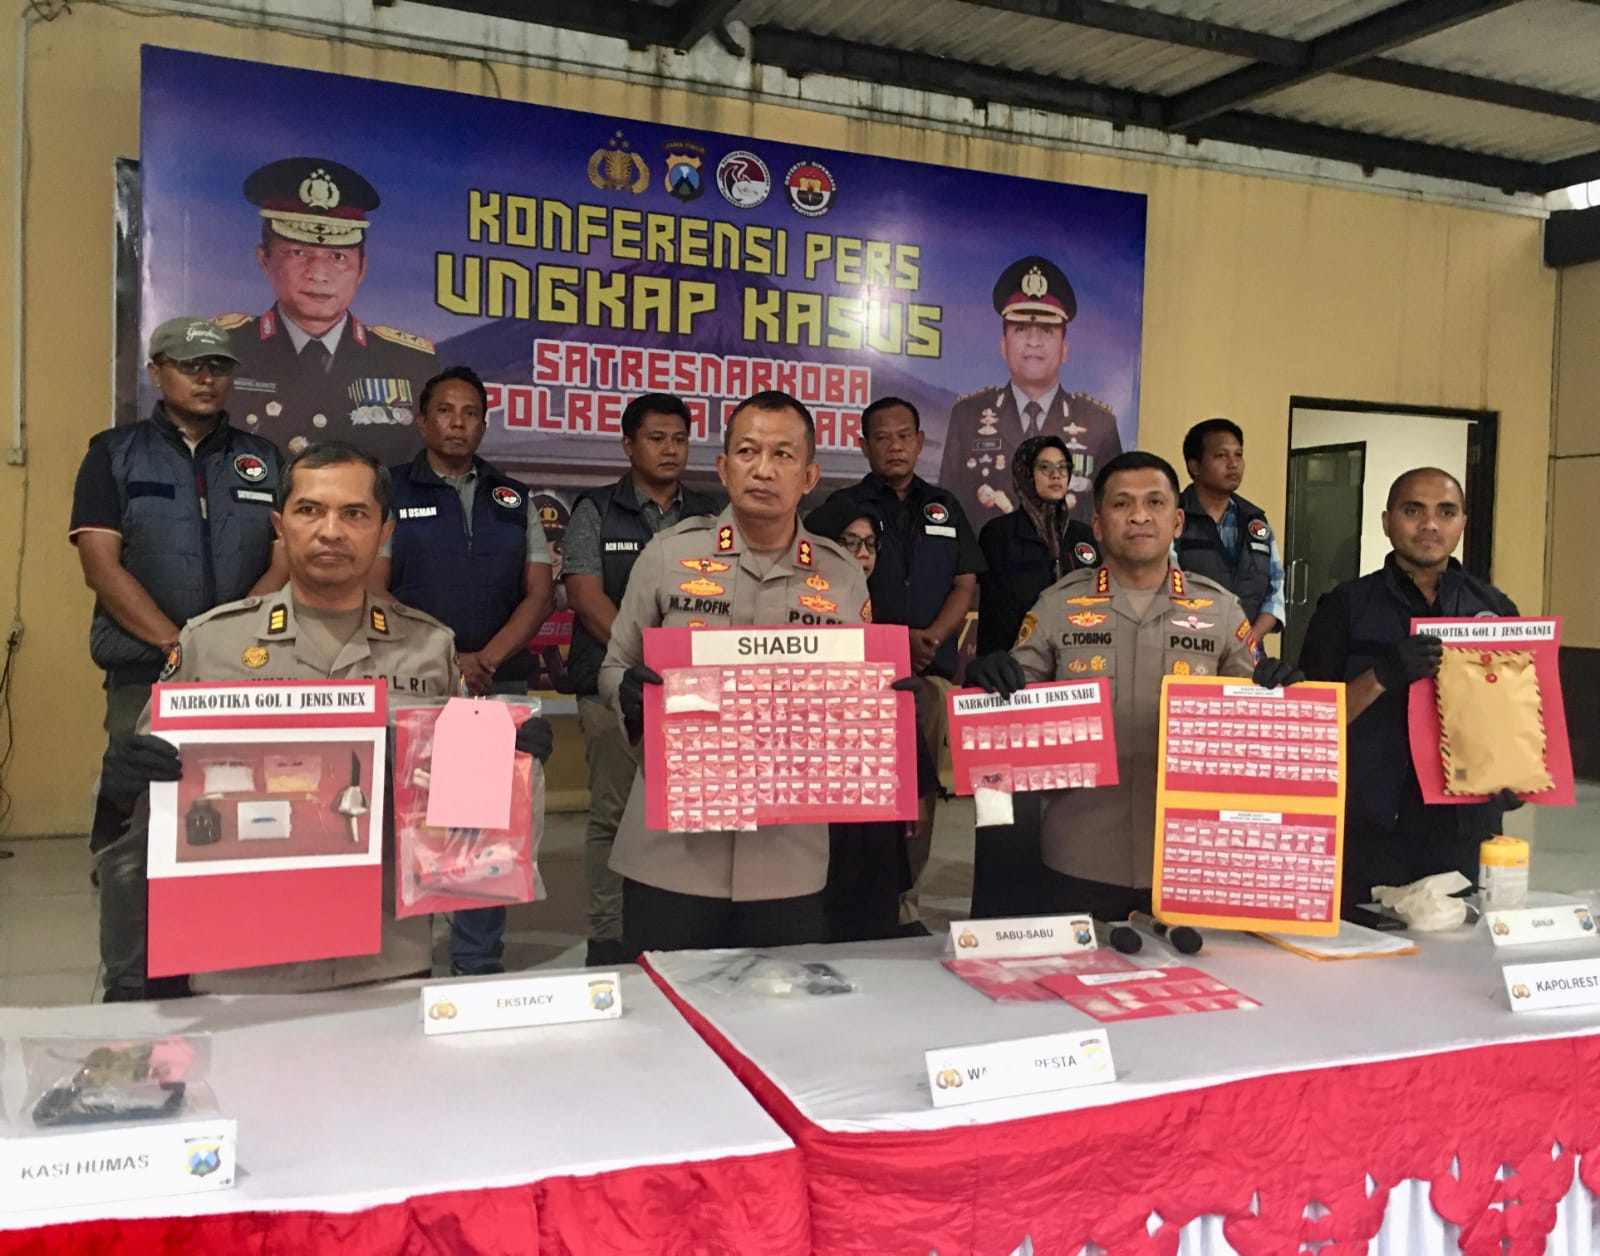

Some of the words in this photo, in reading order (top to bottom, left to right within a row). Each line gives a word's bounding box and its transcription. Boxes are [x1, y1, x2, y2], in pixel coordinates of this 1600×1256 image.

[469, 191, 787, 276] KONFERENSI
[805, 233, 920, 290] PERS
[436, 252, 717, 335] UNGKAP
[744, 287, 943, 358] KASUS
[534, 340, 869, 403] SATRESNARKOBA
[484, 383, 707, 439] POLREA
[738, 636, 819, 655] SHABU
[1170, 635, 1215, 652] POLRI
[170, 693, 250, 710] NARKOTIKA
[255, 693, 282, 708] GOL
[286, 693, 292, 708] I
[300, 692, 333, 708] JENIS
[337, 692, 366, 707] INEX
[1014, 693, 1033, 705] GOL
[1045, 690, 1069, 704] JENIS
[1071, 687, 1095, 701] SABU
[995, 929, 1055, 941] SABU-SABU
[76, 1154, 149, 1176] HUMAS
